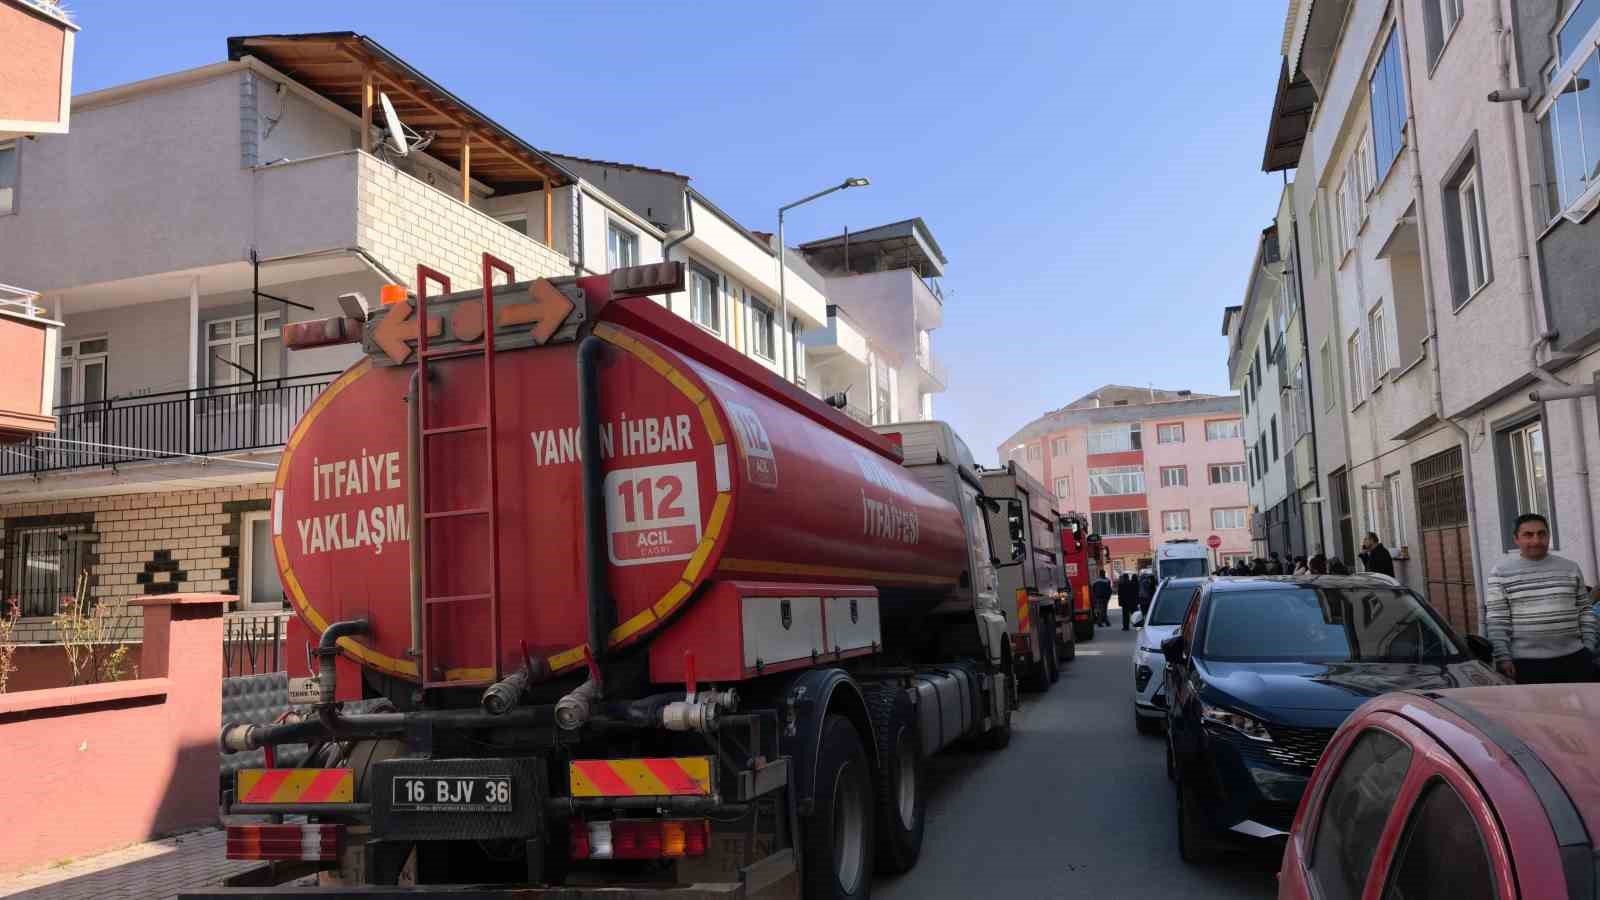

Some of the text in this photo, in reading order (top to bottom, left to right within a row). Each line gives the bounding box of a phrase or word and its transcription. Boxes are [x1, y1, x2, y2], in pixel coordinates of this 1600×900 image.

[531, 411, 693, 466] YANN İHBAR
[313, 447, 401, 501] İTFAİYE
[617, 475, 685, 522] 112
[405, 780, 509, 803] 16 BJV 36
